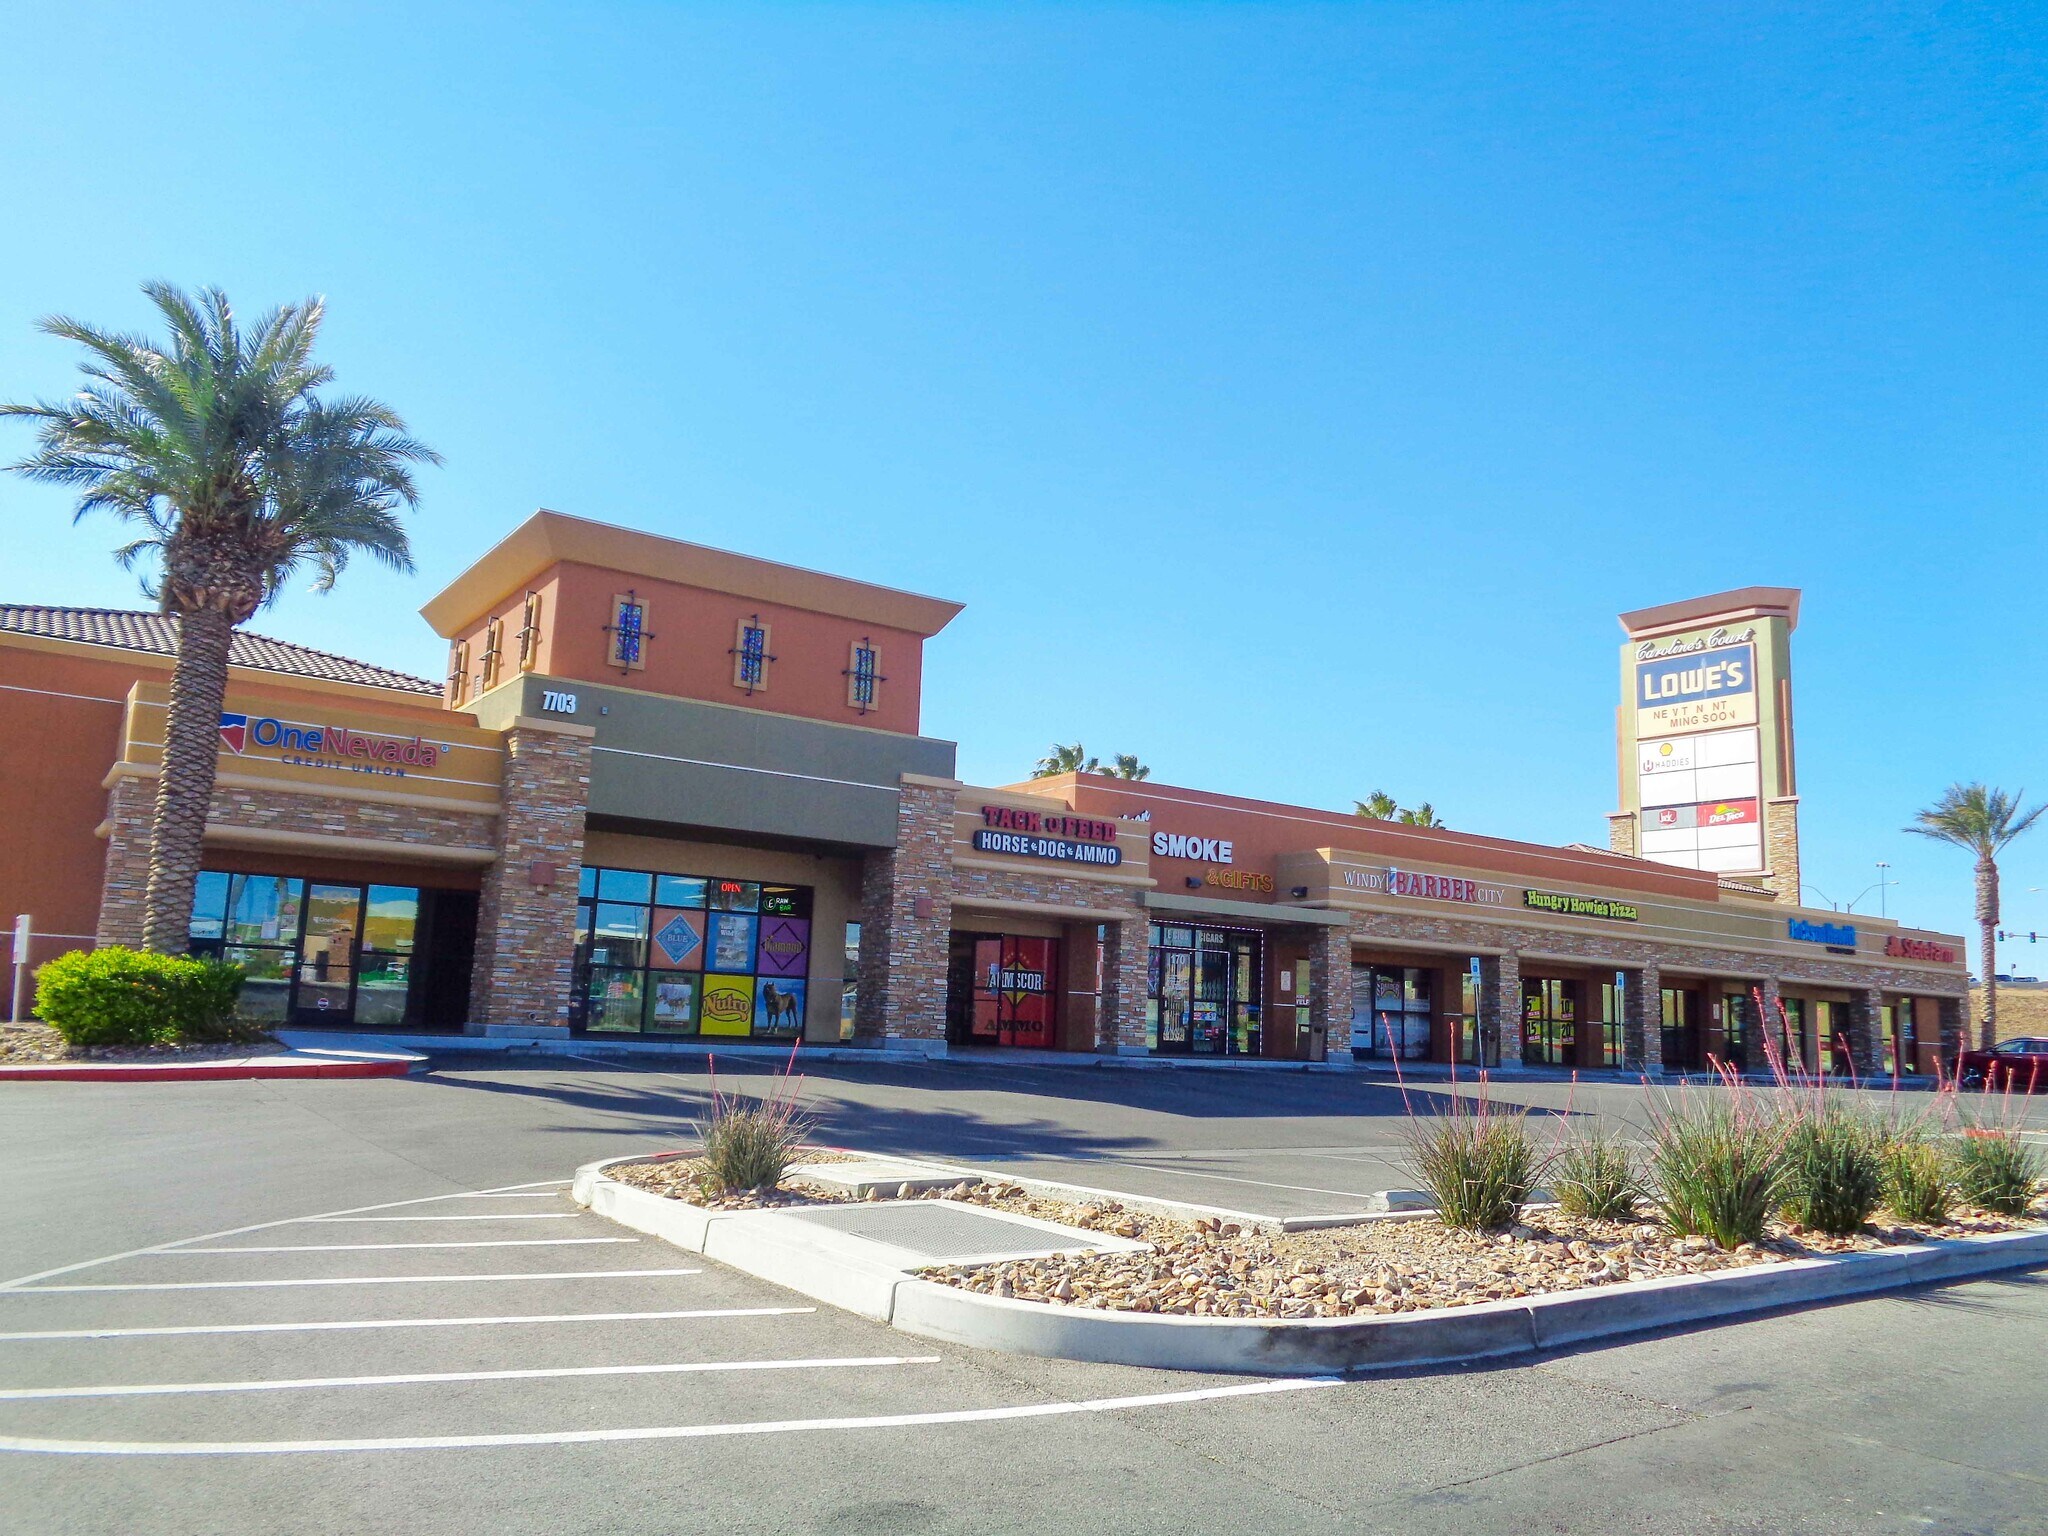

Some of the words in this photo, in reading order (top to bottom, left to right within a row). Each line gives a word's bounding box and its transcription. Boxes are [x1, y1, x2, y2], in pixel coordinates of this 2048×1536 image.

[1636, 641, 1704, 661] Caroline's
[1708, 627, 1755, 649] Court
[1644, 661, 1744, 700] LOWE'S
[542, 690, 576, 714] 7703
[1670, 715, 1699, 728] MING
[281, 755, 342, 770] CREDIT
[352, 763, 405, 778] UNION
[983, 806, 1041, 832] TACK
[1064, 817, 1117, 842] FEED
[982, 832, 1028, 853] HORSE
[1038, 839, 1066, 858] DOG
[1074, 845, 1117, 864] AMMO
[1153, 831, 1232, 864] SMOKE
[721, 882, 741, 893] OPEN
[1220, 869, 1273, 893] GIFTS
[1344, 869, 1383, 889] WINDY
[1397, 871, 1477, 902] BARBER
[1477, 888, 1505, 903] CITY
[1527, 890, 1570, 912] Hungry
[1571, 898, 1609, 916] Howie's
[1609, 902, 1638, 919] Pizza
[667, 934, 689, 943] BLUE
[1199, 931, 1224, 944] CIGARS
[1170, 954, 1185, 965] 170
[702, 993, 748, 1021] Nutro
